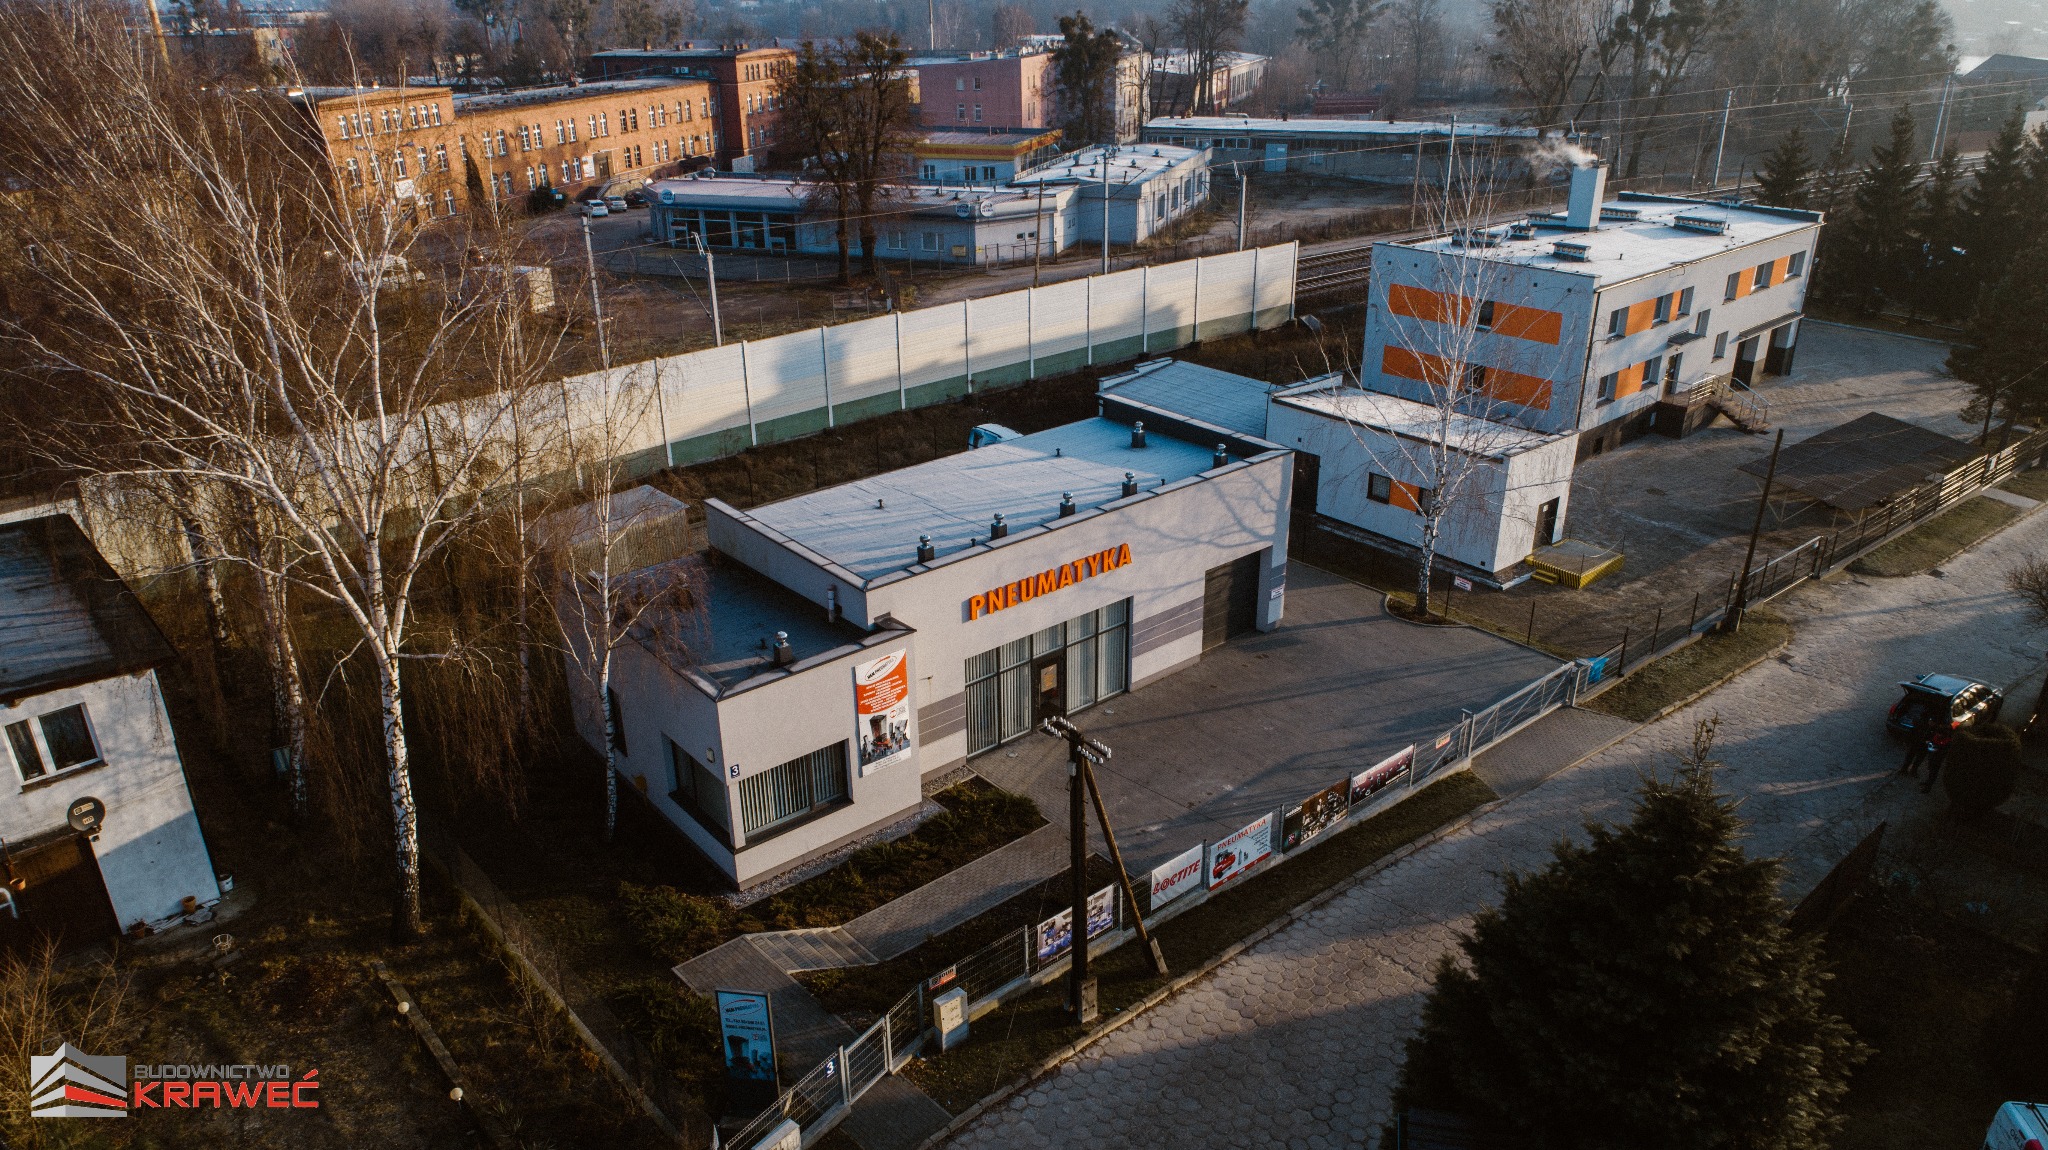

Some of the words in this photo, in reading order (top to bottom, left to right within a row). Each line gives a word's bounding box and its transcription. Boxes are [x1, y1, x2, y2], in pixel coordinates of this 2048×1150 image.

[969, 543, 1132, 621] PNEUMATYKA
[731, 765, 739, 776] 3
[1217, 818, 1267, 851] PNEUMATYKA
[1152, 858, 1201, 896] LOCTITE
[826, 1060, 835, 1075] 3
